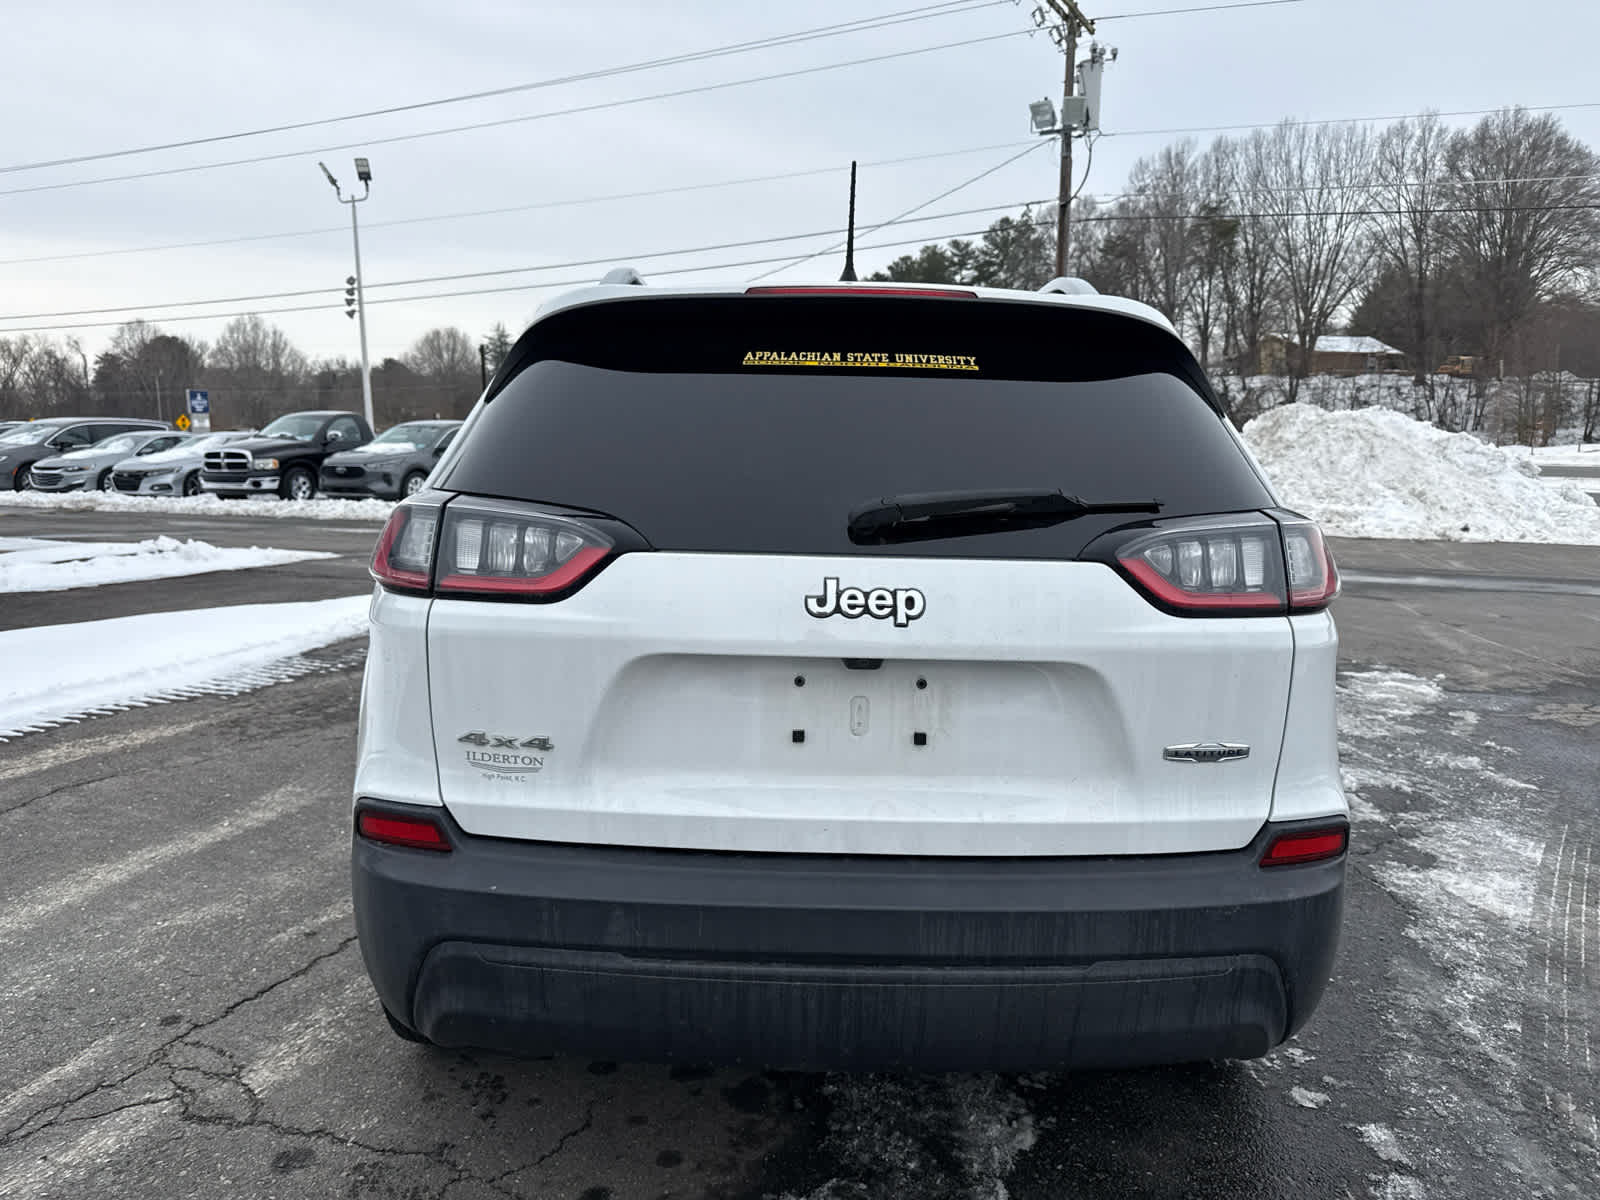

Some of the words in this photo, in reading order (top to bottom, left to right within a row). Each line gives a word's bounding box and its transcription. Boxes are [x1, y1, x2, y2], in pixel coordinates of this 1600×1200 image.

[744, 351, 841, 361] APPALACHIAN
[847, 352, 889, 362] STATE
[895, 353, 976, 366] UNIVERSITY
[804, 576, 926, 627] Jeep
[466, 751, 544, 766] ILDERTON
